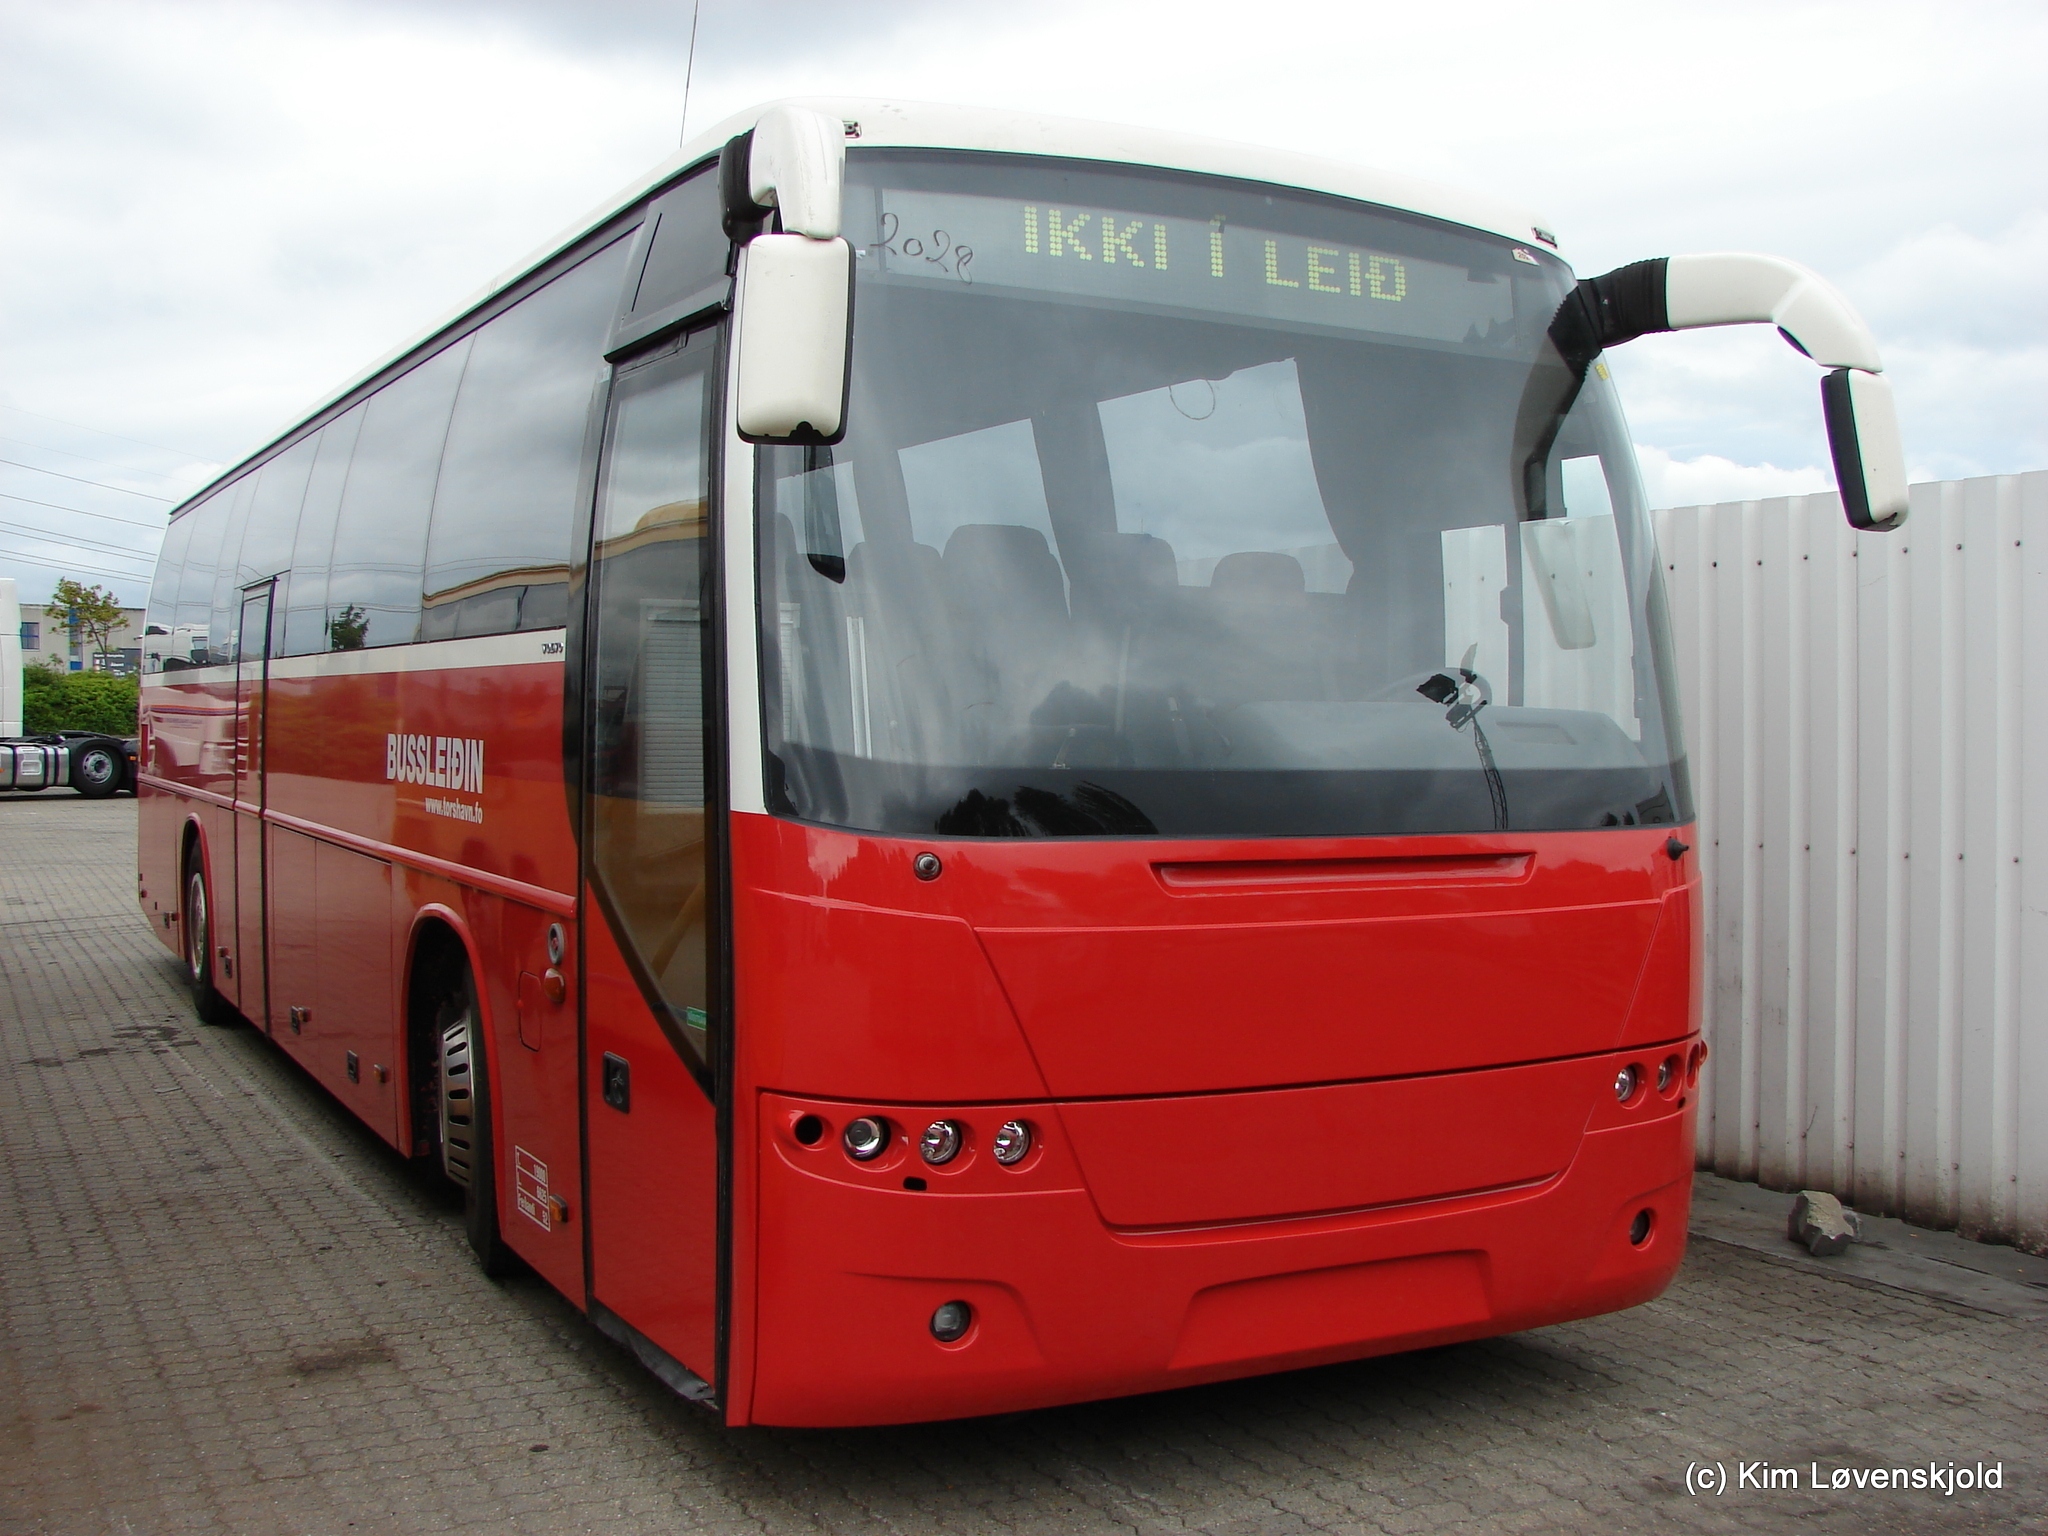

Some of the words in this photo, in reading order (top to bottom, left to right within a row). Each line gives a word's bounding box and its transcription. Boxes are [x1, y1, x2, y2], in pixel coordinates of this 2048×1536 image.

[869, 212, 974, 285] 2028
[1023, 205, 1168, 270] IKKI
[1264, 239, 1407, 302] LEIÐ
[386, 733, 484, 794] BUSSLEIÐIN
[425, 796, 483, 825] www.torshavn.fo
